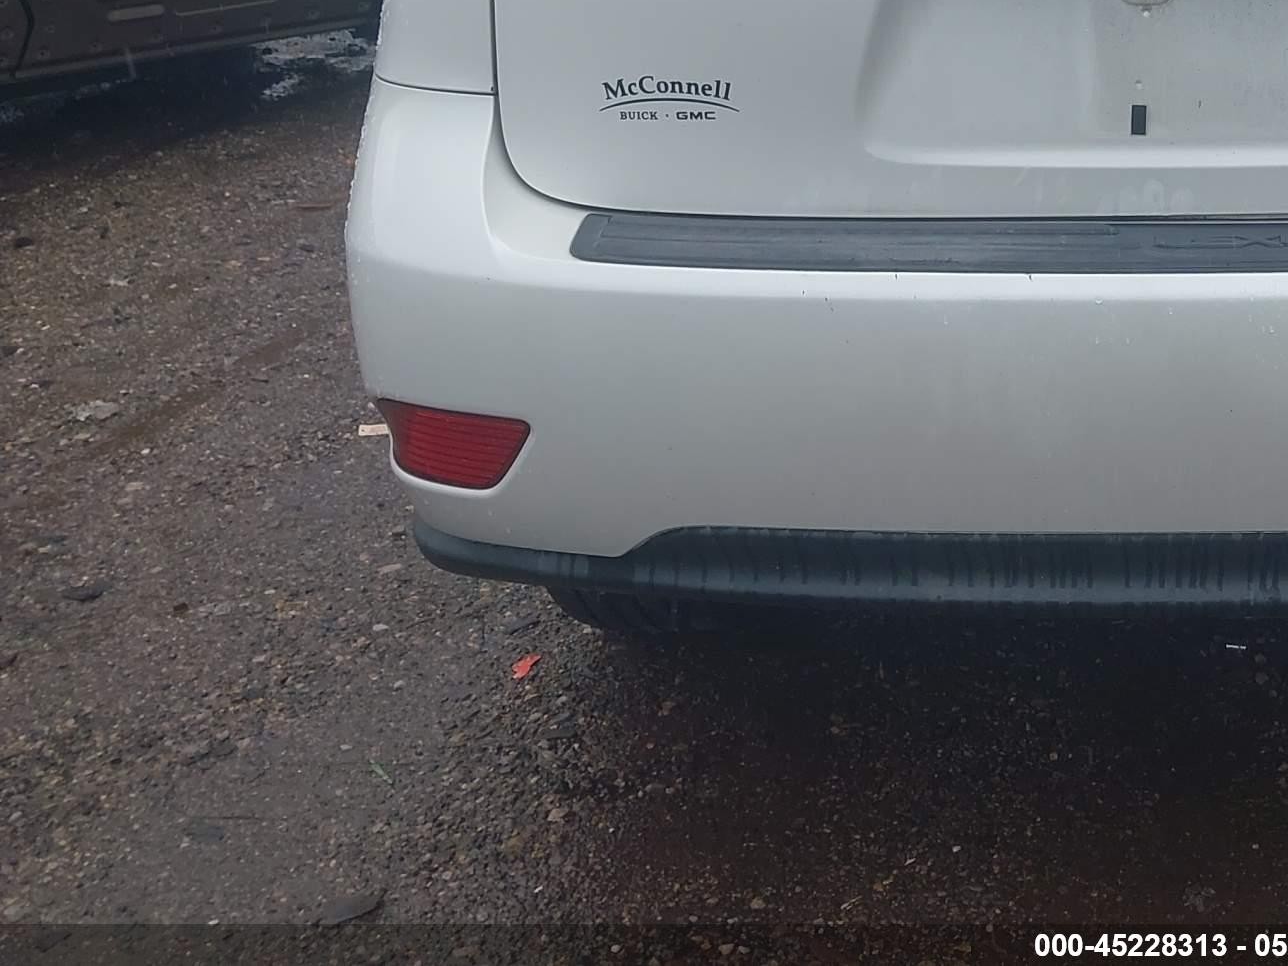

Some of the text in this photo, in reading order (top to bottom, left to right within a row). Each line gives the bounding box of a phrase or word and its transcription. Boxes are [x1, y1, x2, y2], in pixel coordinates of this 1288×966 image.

[602, 75, 732, 101] McConnell
[619, 111, 717, 121] BUICK GMC
